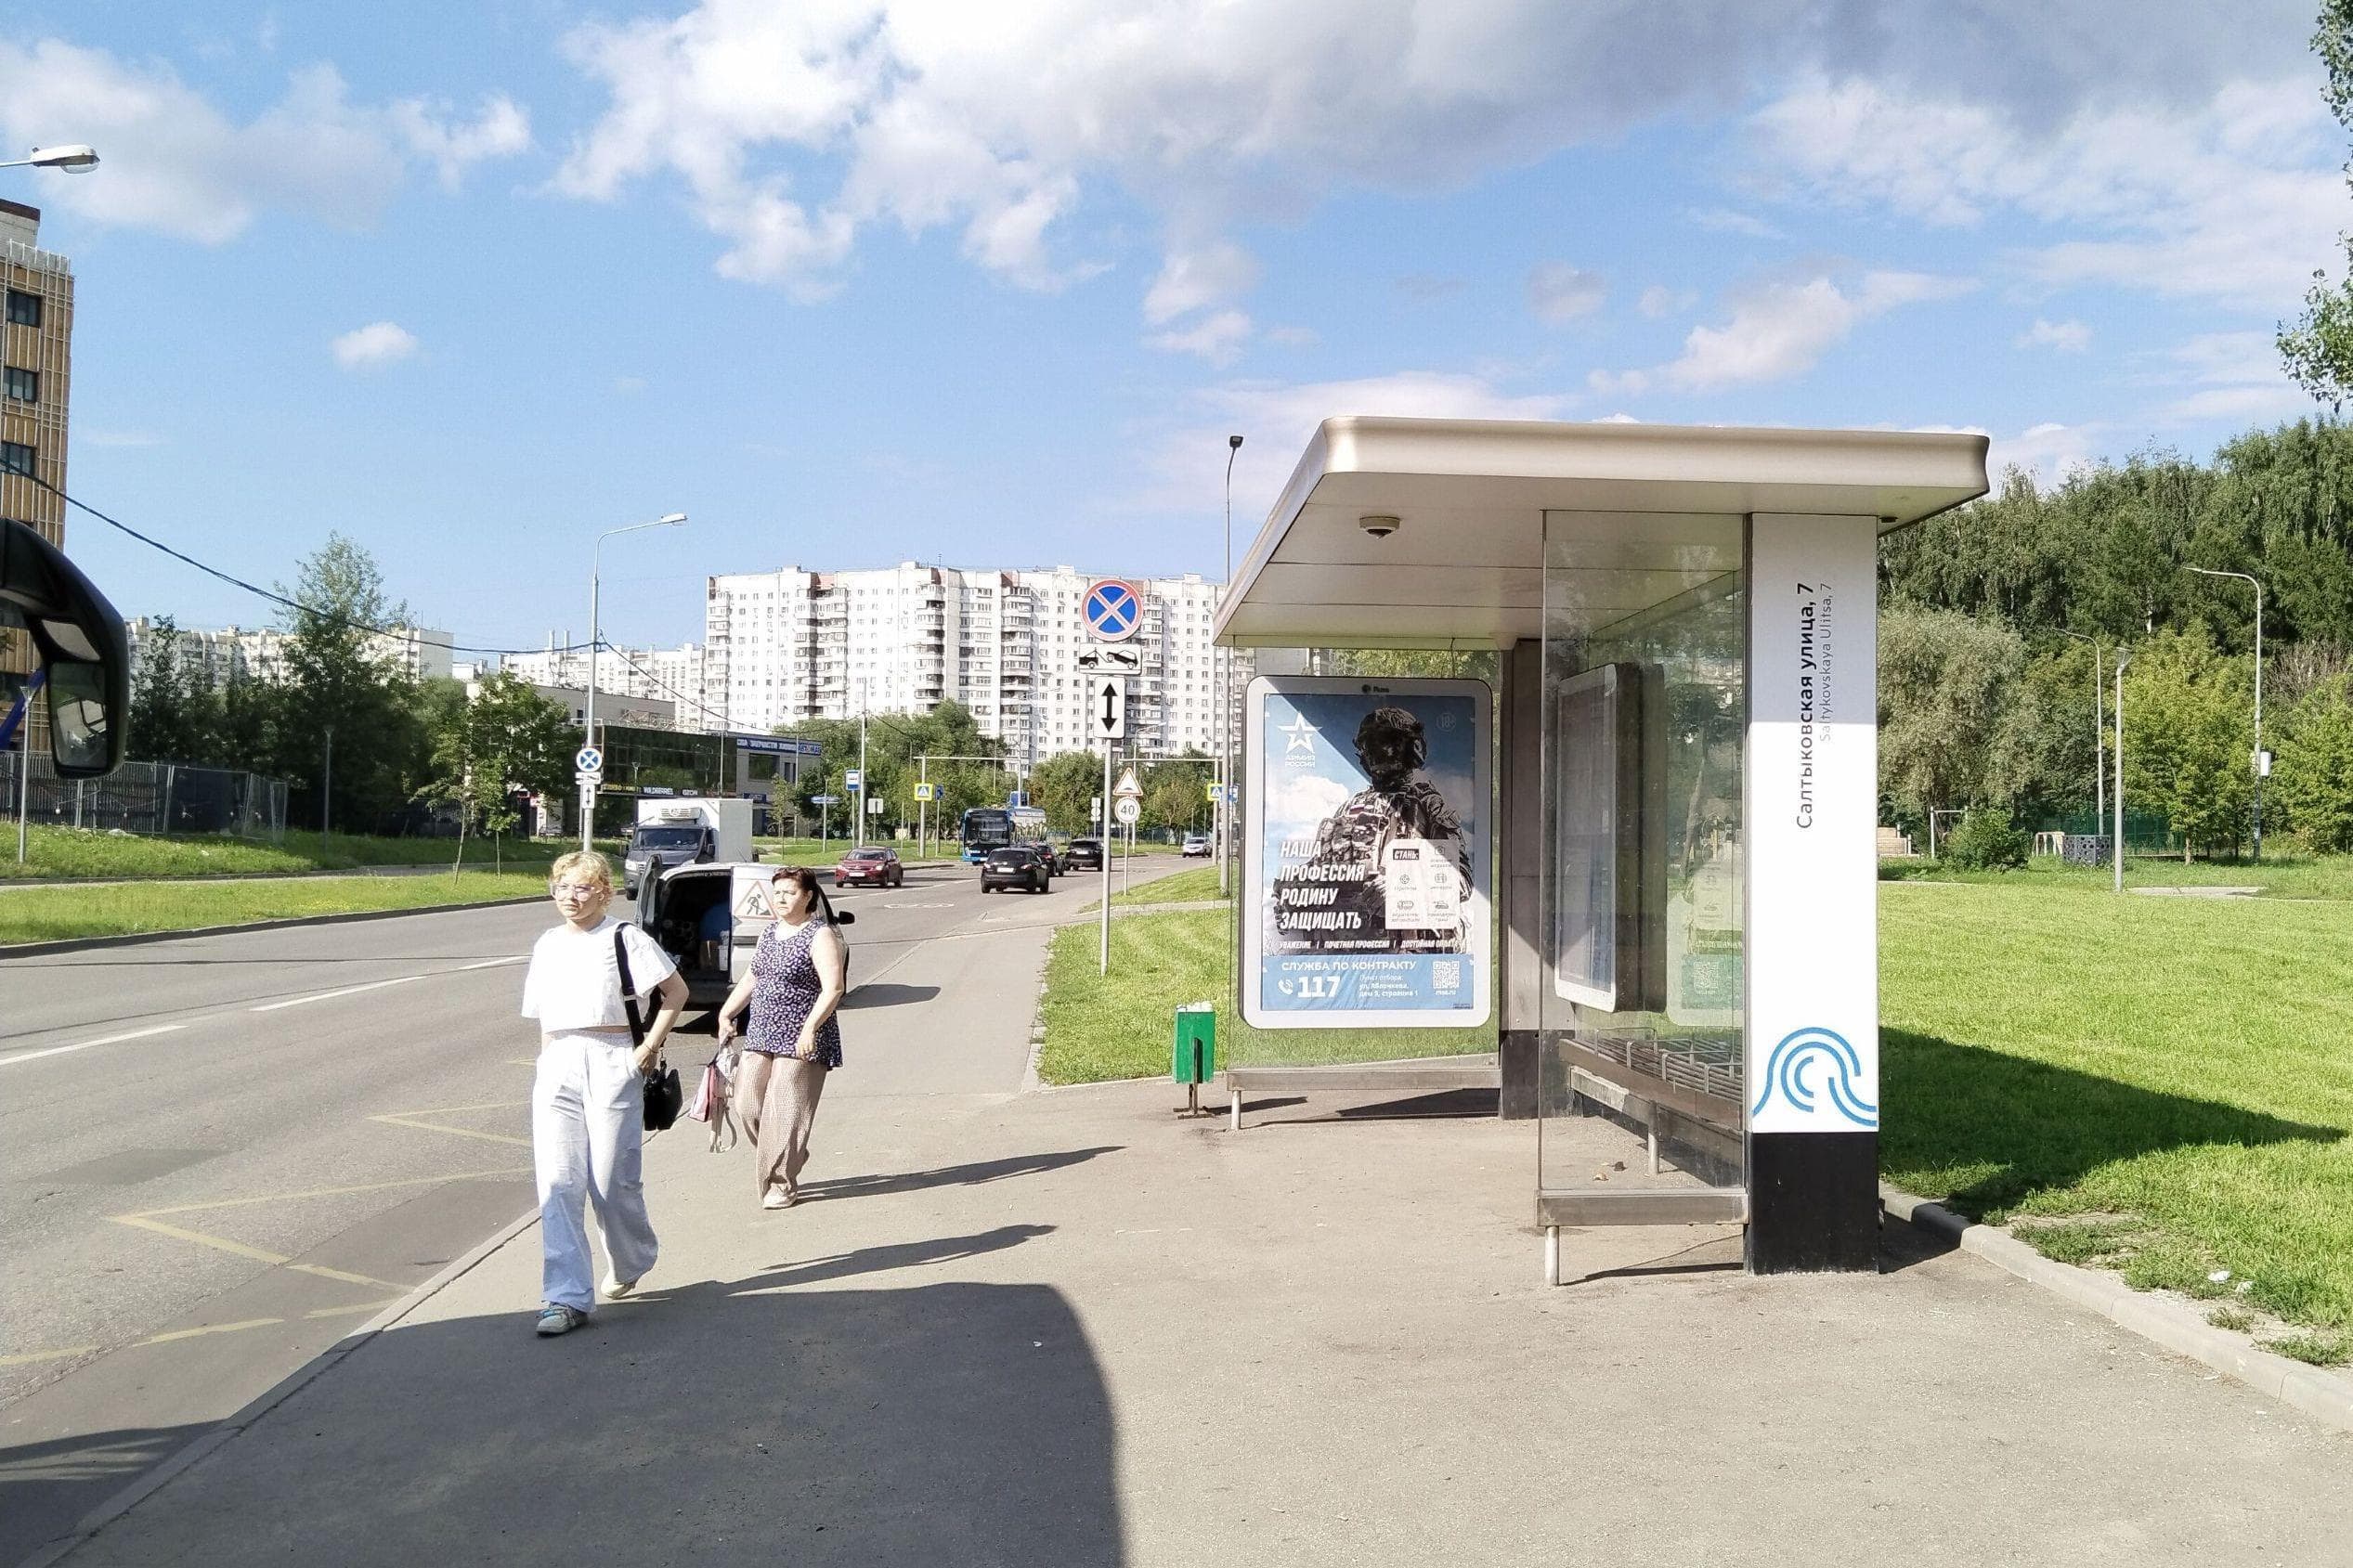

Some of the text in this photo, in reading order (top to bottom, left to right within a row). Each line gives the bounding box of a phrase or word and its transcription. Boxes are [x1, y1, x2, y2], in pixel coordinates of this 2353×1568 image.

[1819, 583, 1834, 742] Saltykovskaya Ulitsa, 7
[1797, 582, 1817, 828] Салтыковская улица, 7
[1121, 804, 1136, 816] 40
[1280, 840, 1321, 858] НАША
[1394, 849, 1419, 860] СТАНЬ:
[1280, 864, 1366, 882] ПРОФЕССИЯ
[1280, 888, 1339, 907] РОДИНУ
[1280, 912, 1362, 931] ЗАЩИЩАТЬ
[1281, 961, 1417, 971] СЛУЖБА ПО КОНТРАКТУ
[1297, 976, 1341, 998] 117
